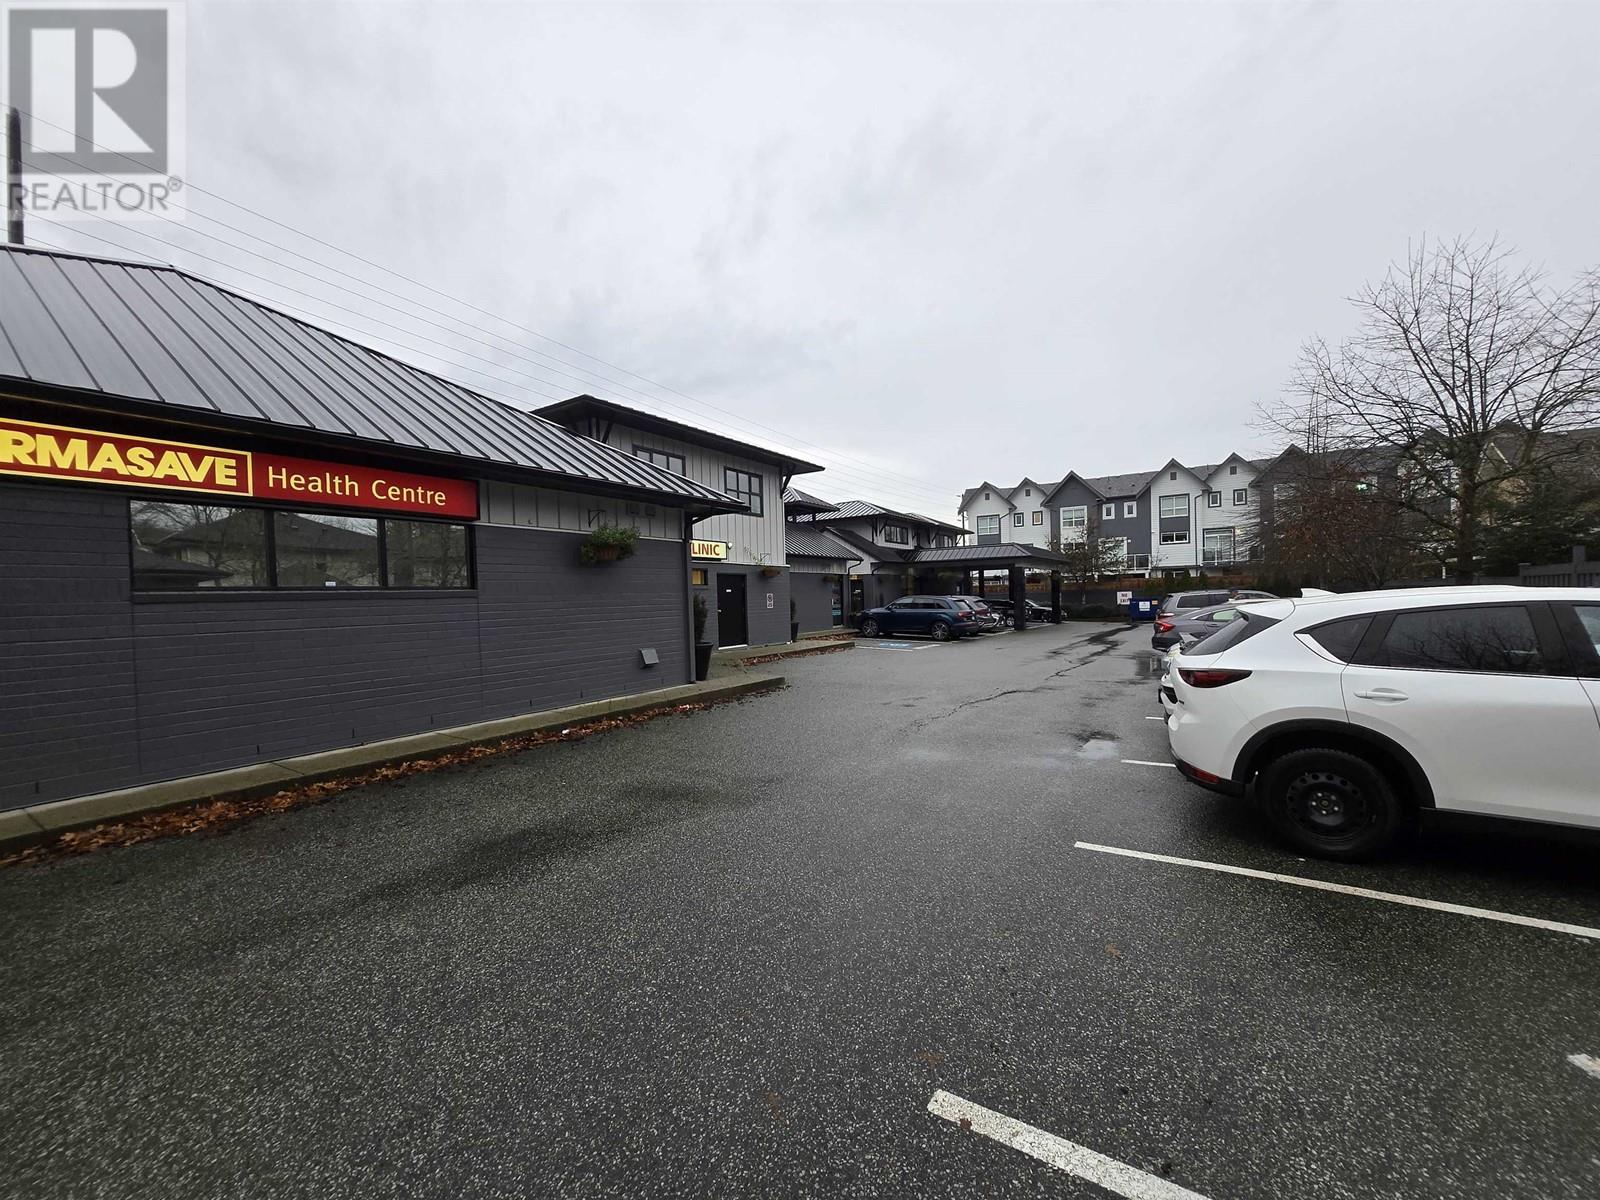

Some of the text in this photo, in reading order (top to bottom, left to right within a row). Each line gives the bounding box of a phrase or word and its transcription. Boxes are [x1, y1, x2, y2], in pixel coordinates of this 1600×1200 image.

[0, 429, 237, 487] RMASAVE
[267, 465, 447, 506] Health Centre
[692, 543, 720, 556] LINIC
